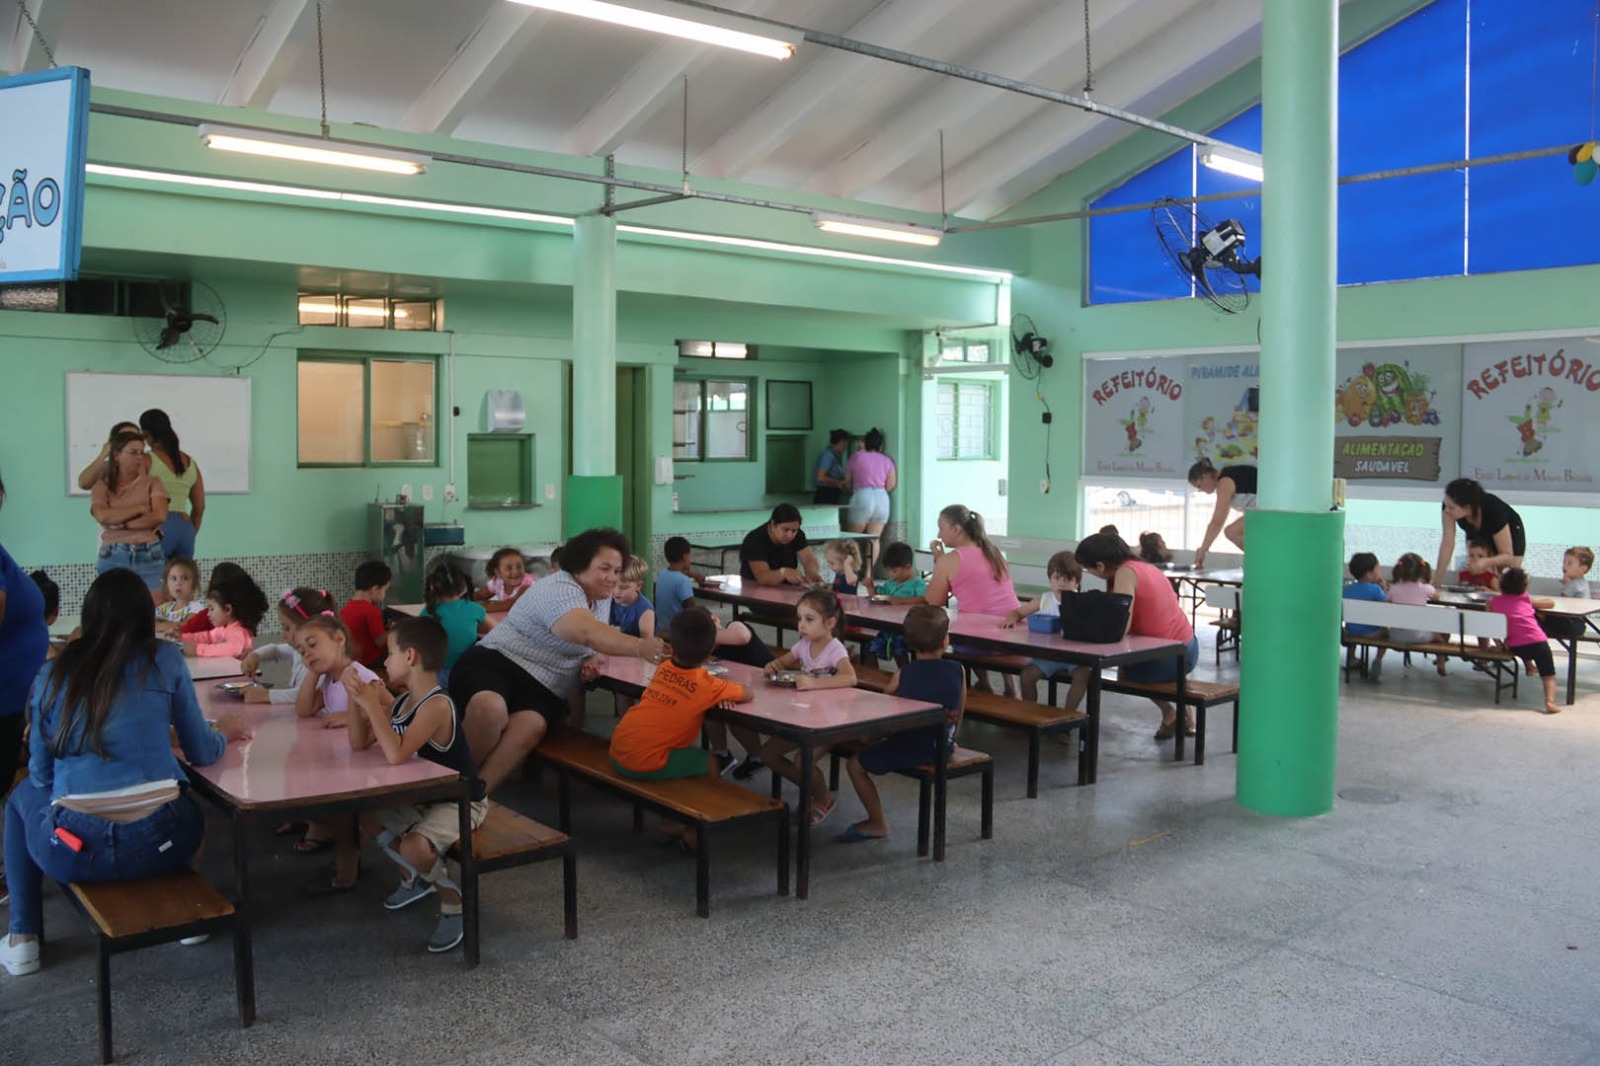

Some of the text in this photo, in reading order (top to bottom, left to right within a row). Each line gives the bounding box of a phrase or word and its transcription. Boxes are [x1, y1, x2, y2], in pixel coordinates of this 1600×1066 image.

[0, 168, 61, 244] ÃO
[1092, 366, 1182, 406] REFEITÓRIO
[1467, 348, 1600, 400] REFEITÓRIO
[660, 667, 698, 693] PEDRAS
